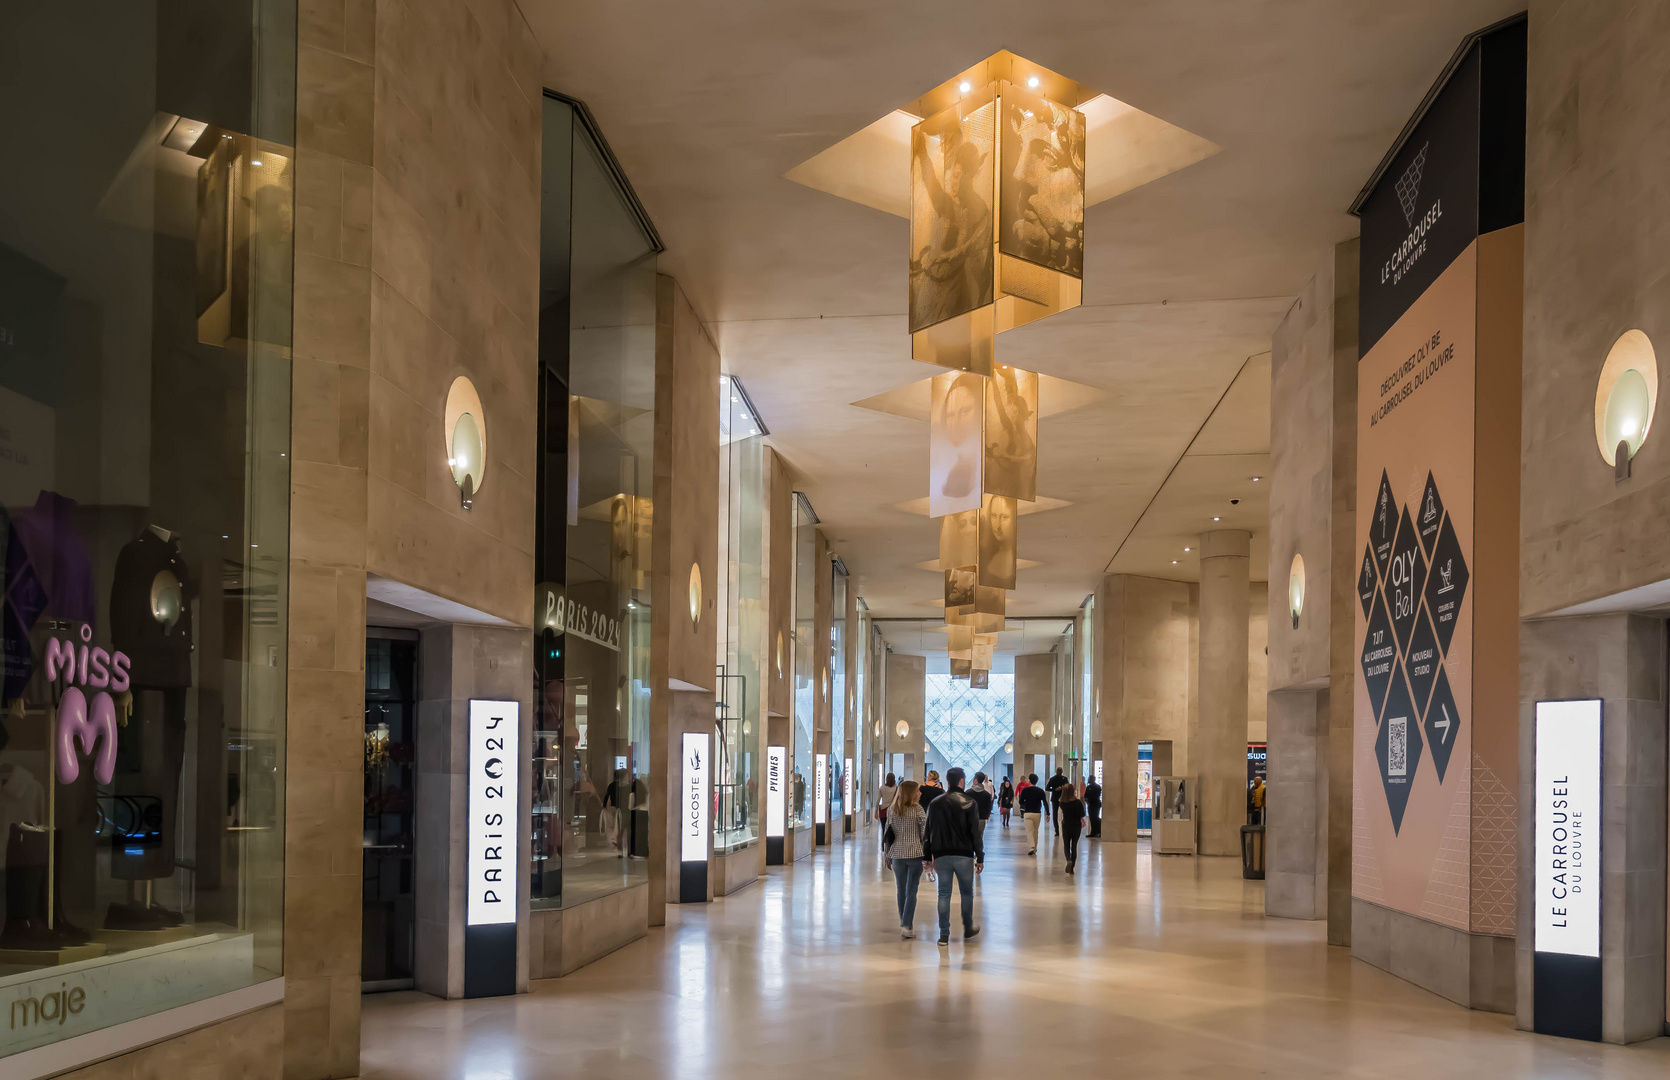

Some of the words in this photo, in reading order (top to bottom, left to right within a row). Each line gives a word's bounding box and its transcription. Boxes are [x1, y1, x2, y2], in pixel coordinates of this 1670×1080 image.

[1381, 260, 1390, 285] LE
[1391, 198, 1443, 272] CARROUSEL
[1393, 267, 1402, 286] DU
[1402, 239, 1427, 275] LOUVRE
[1431, 329, 1441, 351] BE
[1370, 410, 1379, 429] AU
[1379, 381, 1414, 420] CARROUSEL
[1414, 368, 1425, 390] DU
[1425, 342, 1454, 381] LOUVRE
[1367, 665, 1374, 677] DU
[1374, 662, 1390, 675] LOUVRE
[1370, 645, 1393, 661] CARROUSEL
[1412, 648, 1433, 662] NOUVEAU
[1414, 664, 1430, 677] STUDIO
[54, 686, 118, 785] M
[770, 755, 779, 792] PYLONES
[691, 777, 700, 837] LACOSTE
[1552, 775, 1568, 900] CARROUSEL
[1572, 811, 1582, 868] LOUVRE
[1572, 875, 1582, 893] DU
[1552, 906, 1567, 928] LE
[11, 981, 86, 1030] maje
